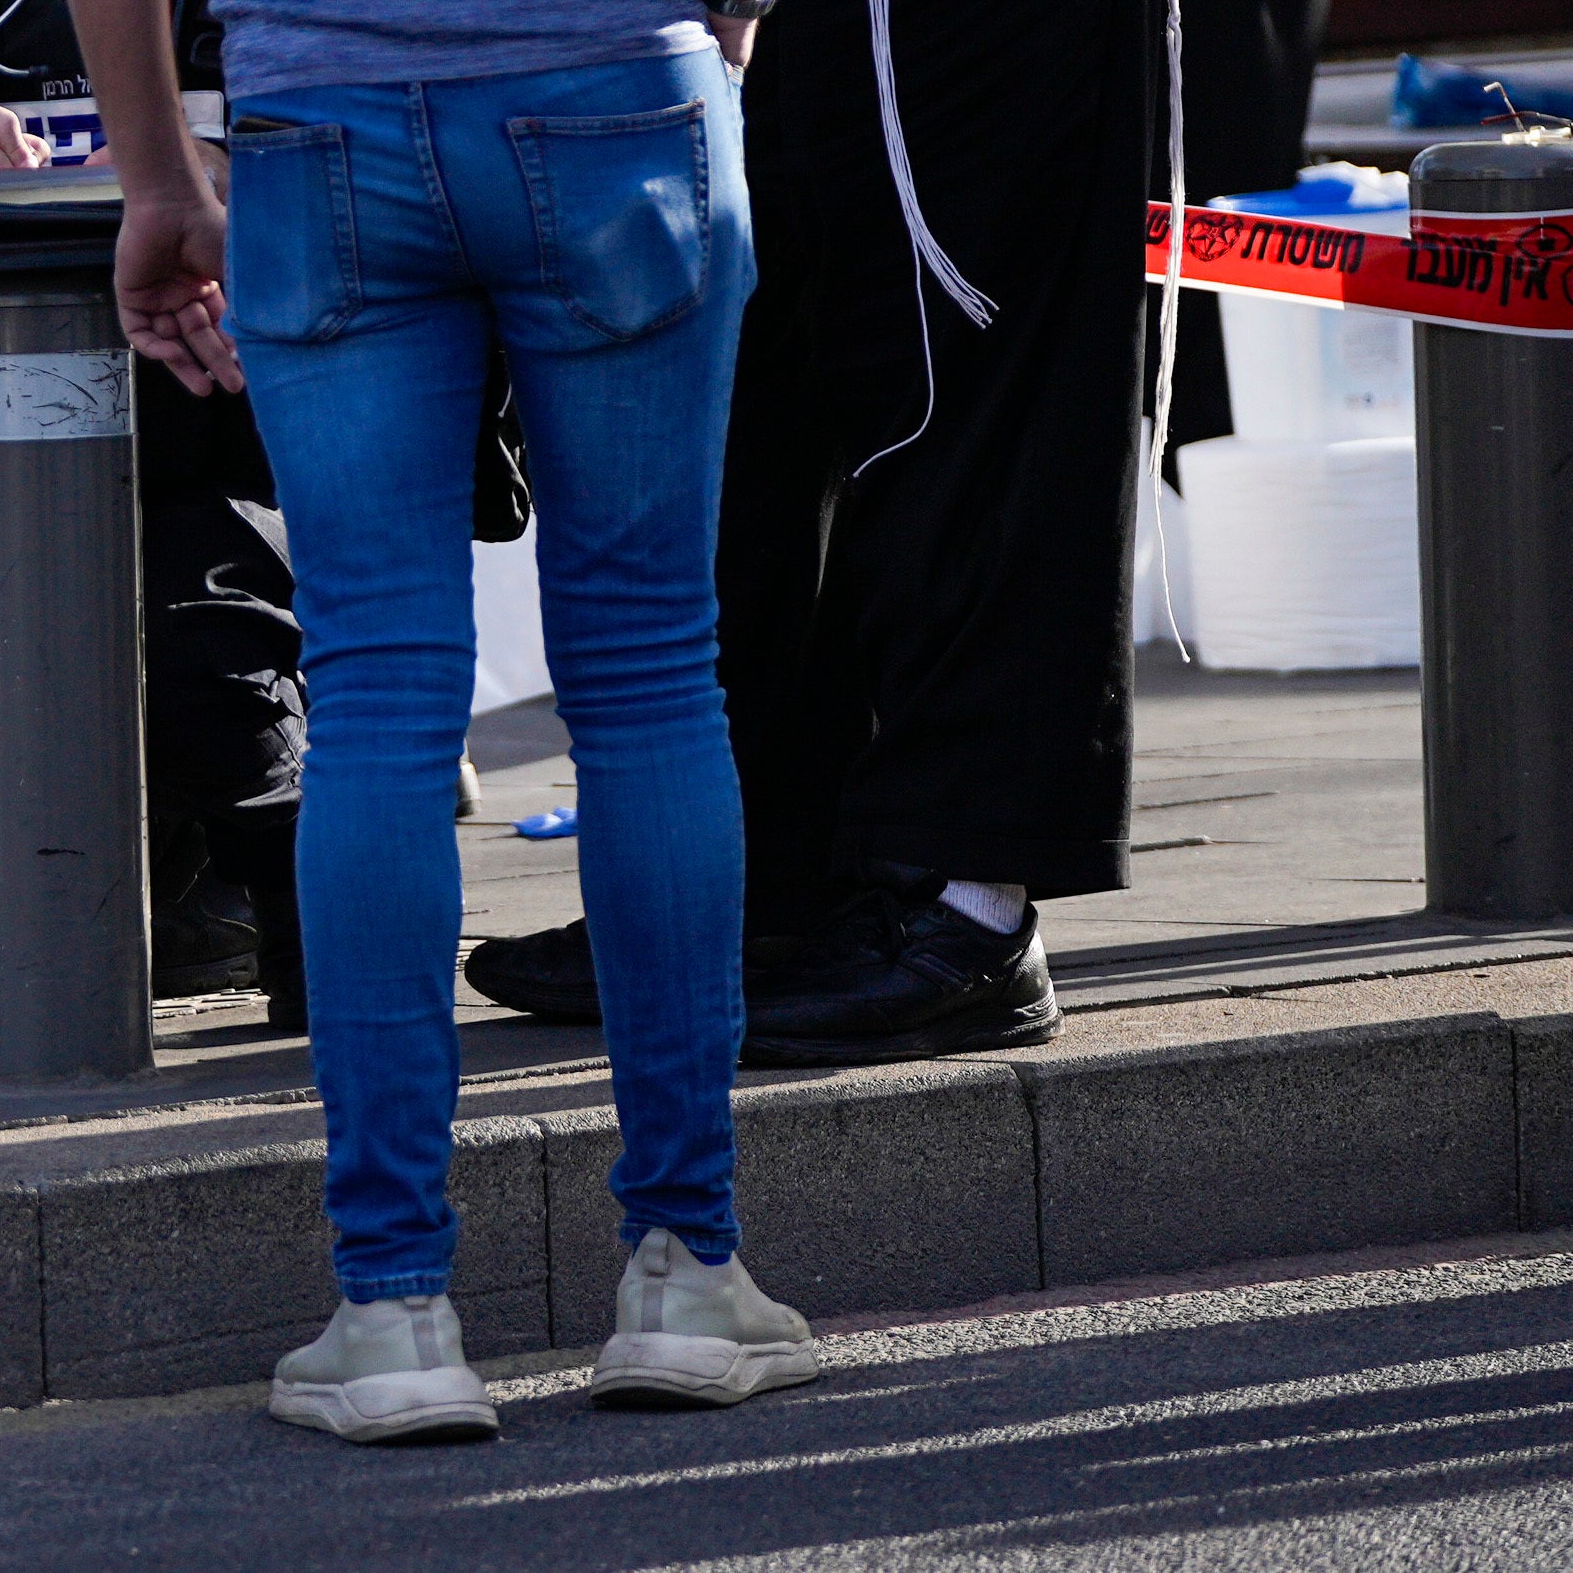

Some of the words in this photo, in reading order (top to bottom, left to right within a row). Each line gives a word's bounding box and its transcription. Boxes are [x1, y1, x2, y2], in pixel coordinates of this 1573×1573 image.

[1240, 221, 1366, 274] משטרת
[1400, 238, 1494, 294] מעבר
[1499, 253, 1552, 307] אין
